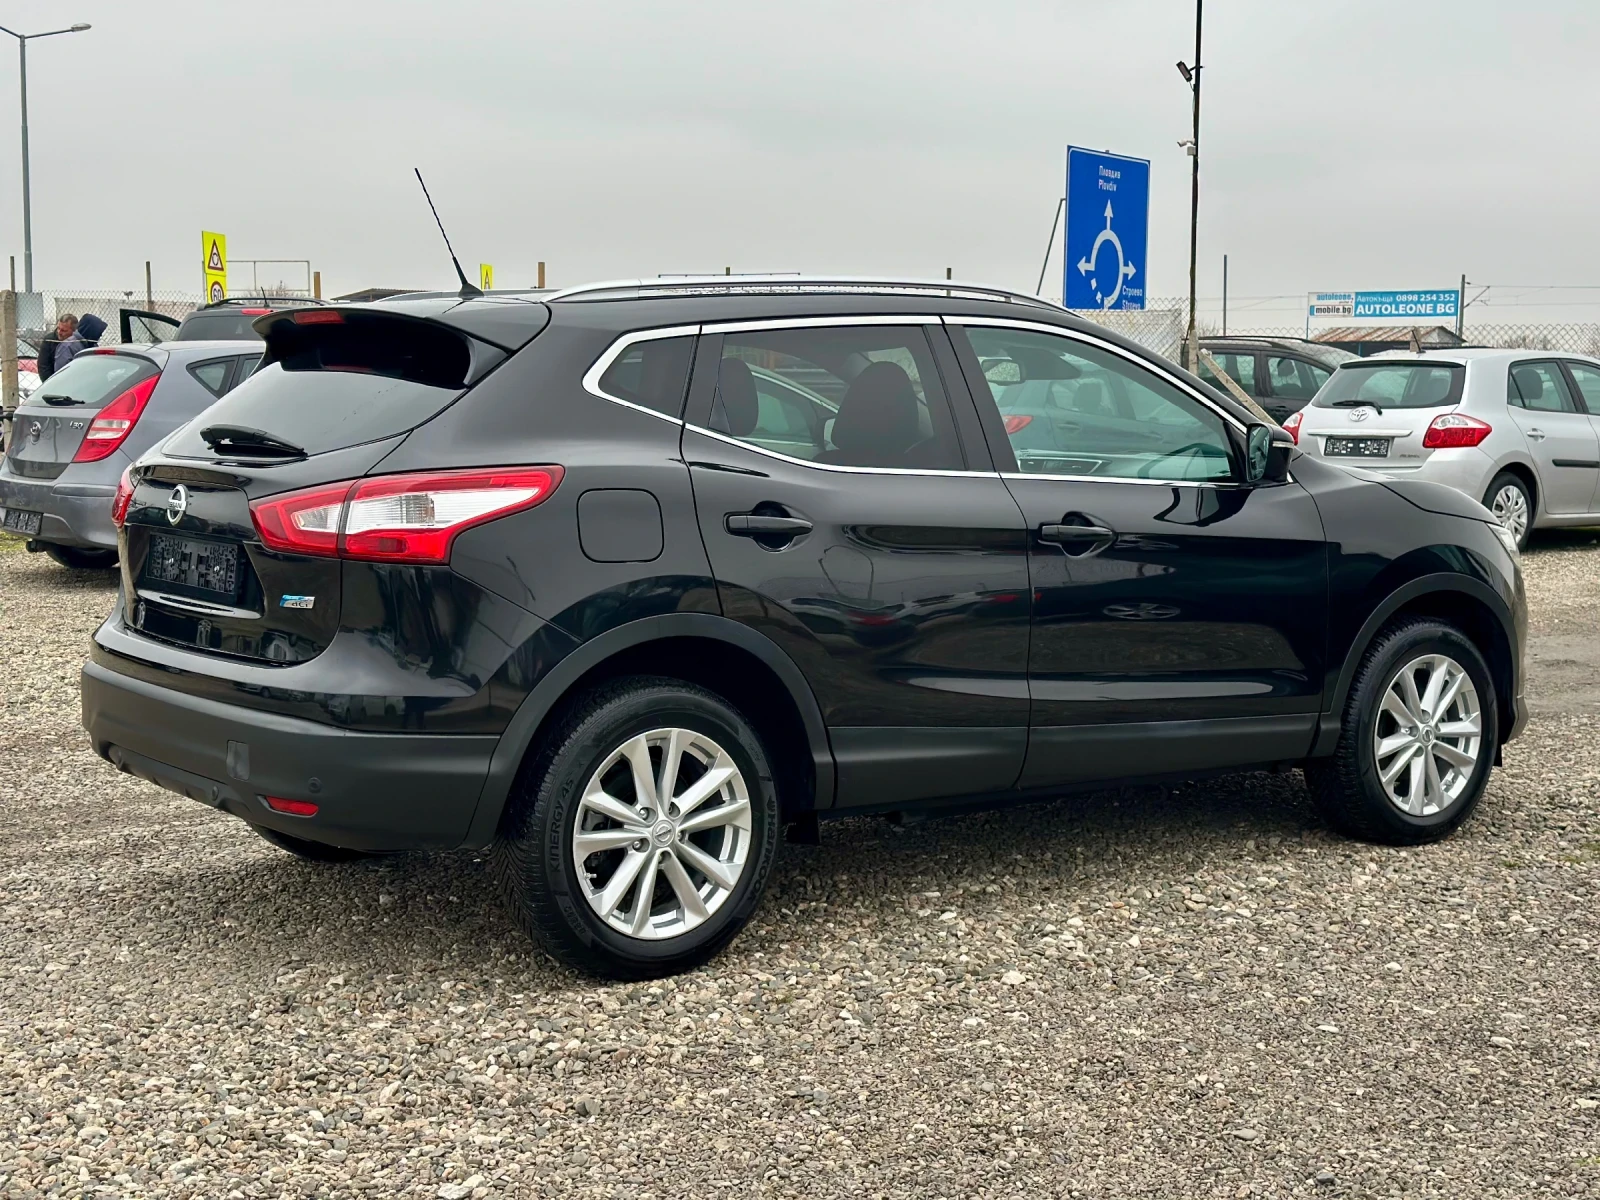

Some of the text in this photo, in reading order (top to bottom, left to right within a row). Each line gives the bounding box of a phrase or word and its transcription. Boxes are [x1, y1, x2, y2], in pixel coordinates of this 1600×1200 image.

[1099, 165, 1121, 179] Пловдив
[1098, 179, 1117, 191] Plovdiv
[1122, 285, 1143, 297] Строево
[1439, 293, 1455, 301] 352
[1315, 305, 1352, 314] mobile.bg
[1356, 303, 1455, 315] AUTOLEONE BG
